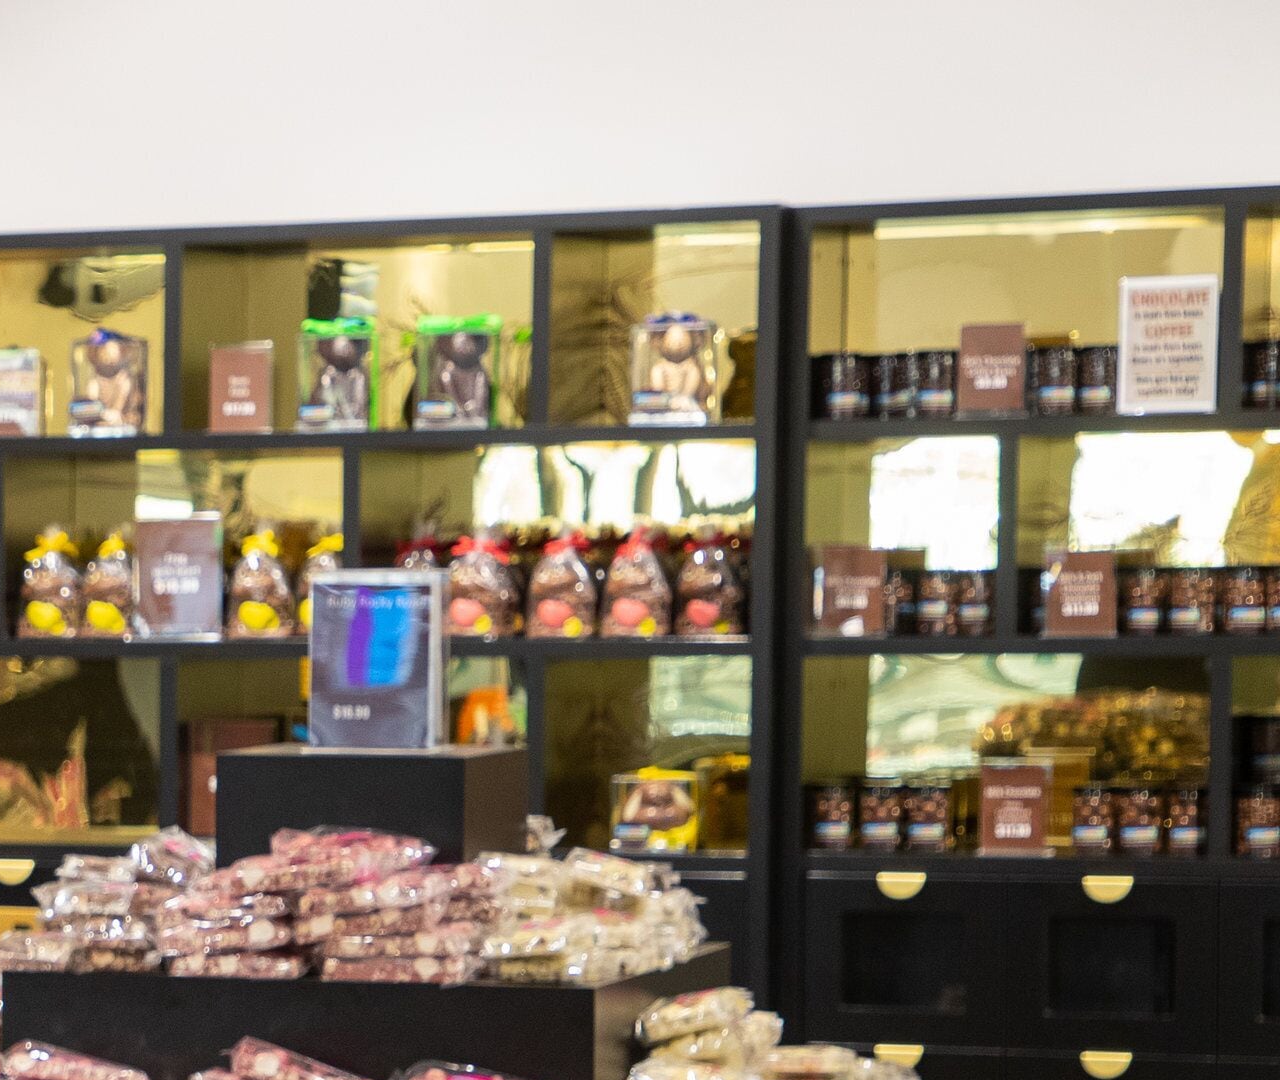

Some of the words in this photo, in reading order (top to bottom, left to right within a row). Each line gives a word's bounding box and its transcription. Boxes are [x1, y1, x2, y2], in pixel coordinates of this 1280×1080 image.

[1131, 290, 1210, 306] CHOCOLATE
[1145, 324, 1194, 338] COFFEE
[328, 595, 356, 609] Ruby
[360, 595, 393, 609] Rocky
